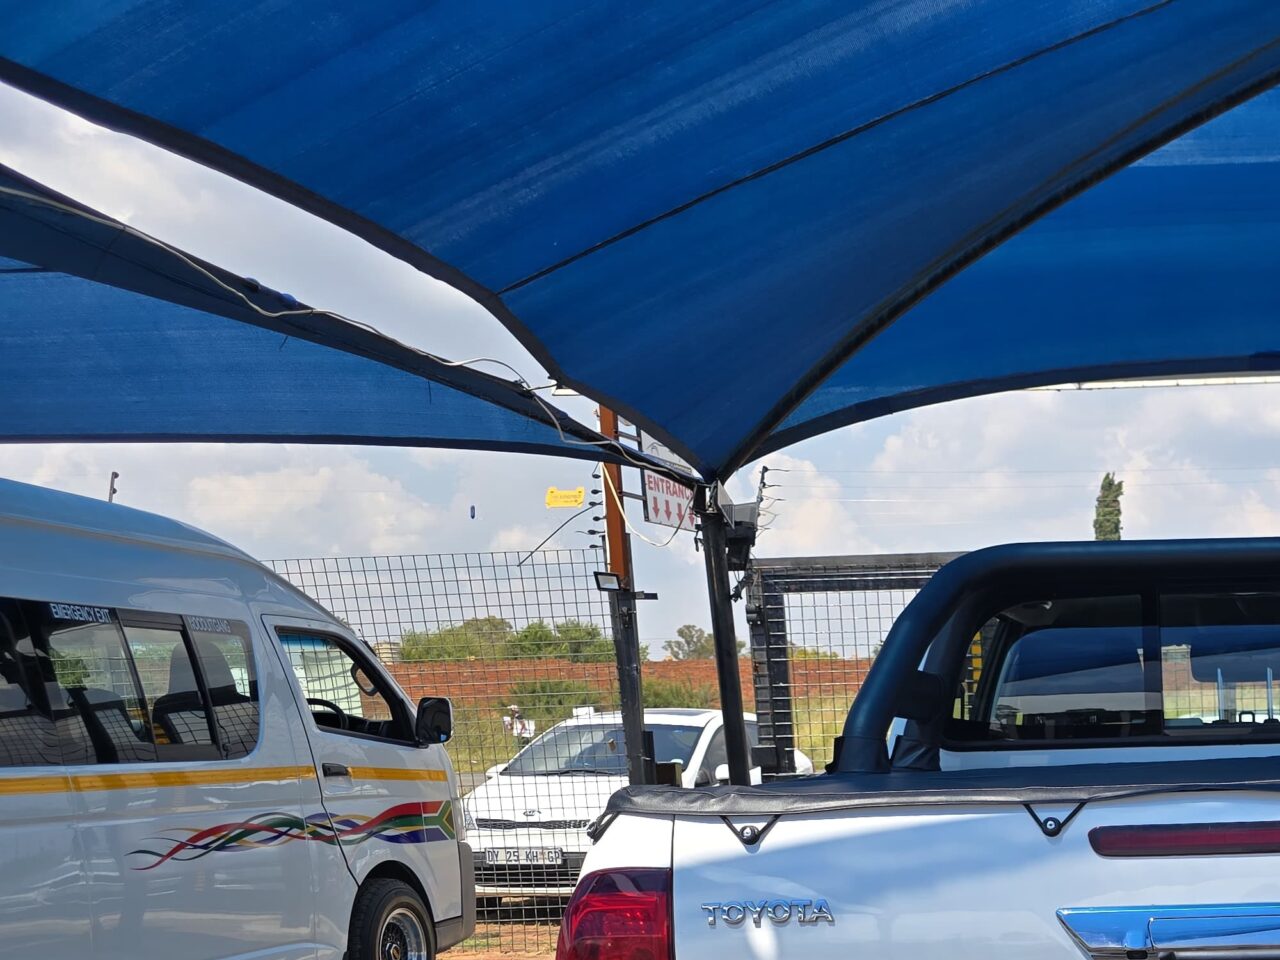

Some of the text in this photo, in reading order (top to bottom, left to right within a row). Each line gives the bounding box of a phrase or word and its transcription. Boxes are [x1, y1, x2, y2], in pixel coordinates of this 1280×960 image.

[647, 474, 693, 500] ENTRANC
[50, 603, 112, 623] EMERGENCY EXIT
[487, 850, 560, 863] DY 25 KH GP
[702, 899, 835, 928] TOYOTA
